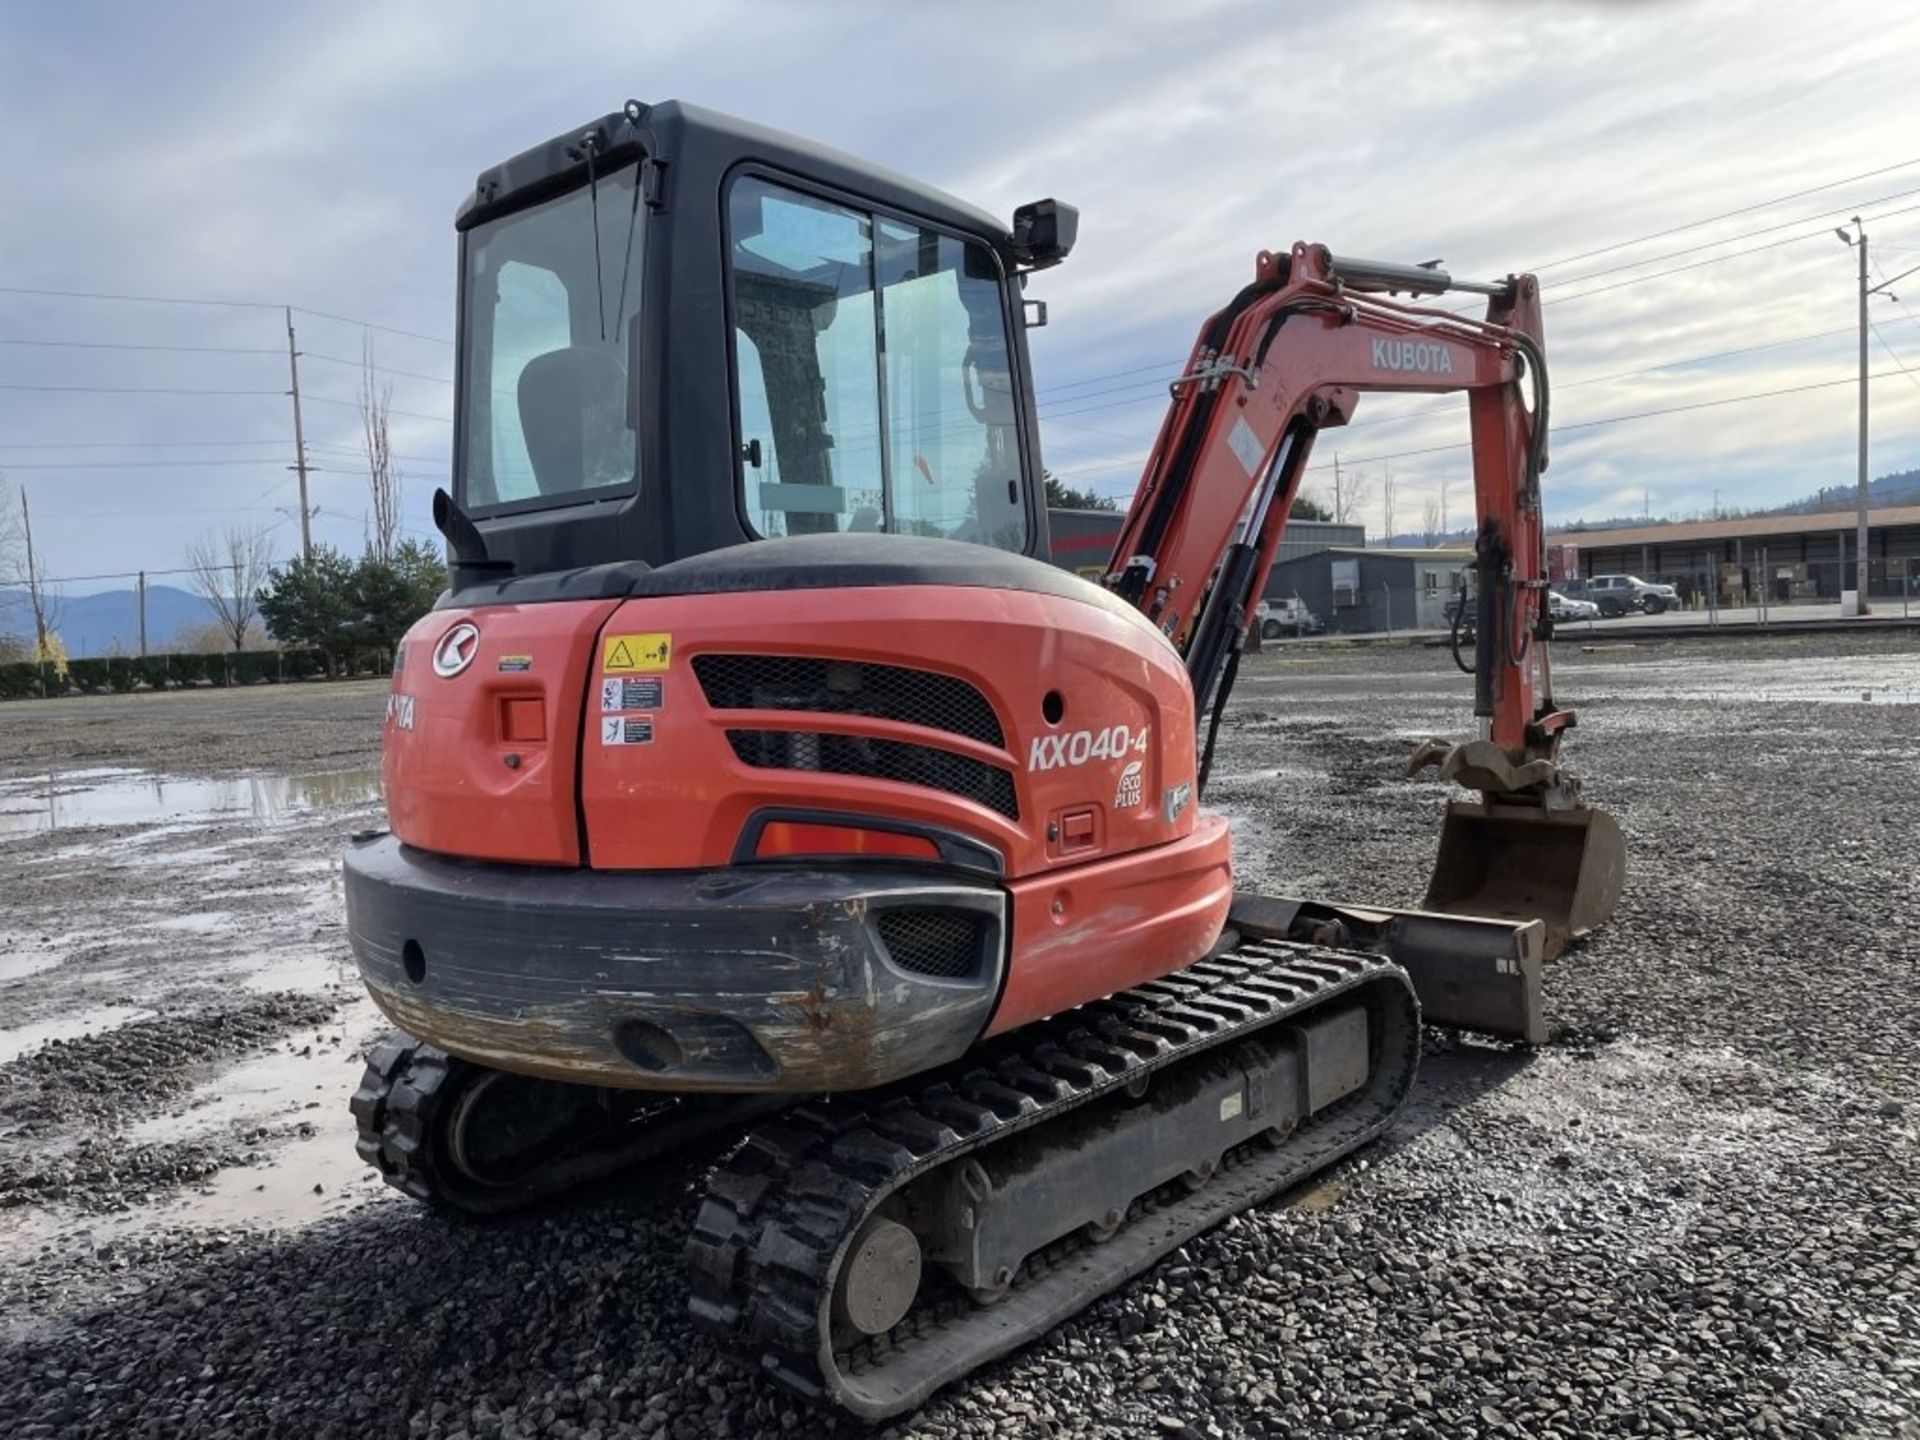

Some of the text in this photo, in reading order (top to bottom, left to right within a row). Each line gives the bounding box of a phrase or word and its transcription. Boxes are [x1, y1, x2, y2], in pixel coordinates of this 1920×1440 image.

[1372, 338, 1452, 373] KUBOTA
[1028, 724, 1148, 772] KX040-4
[1114, 790, 1141, 808] PLUS
